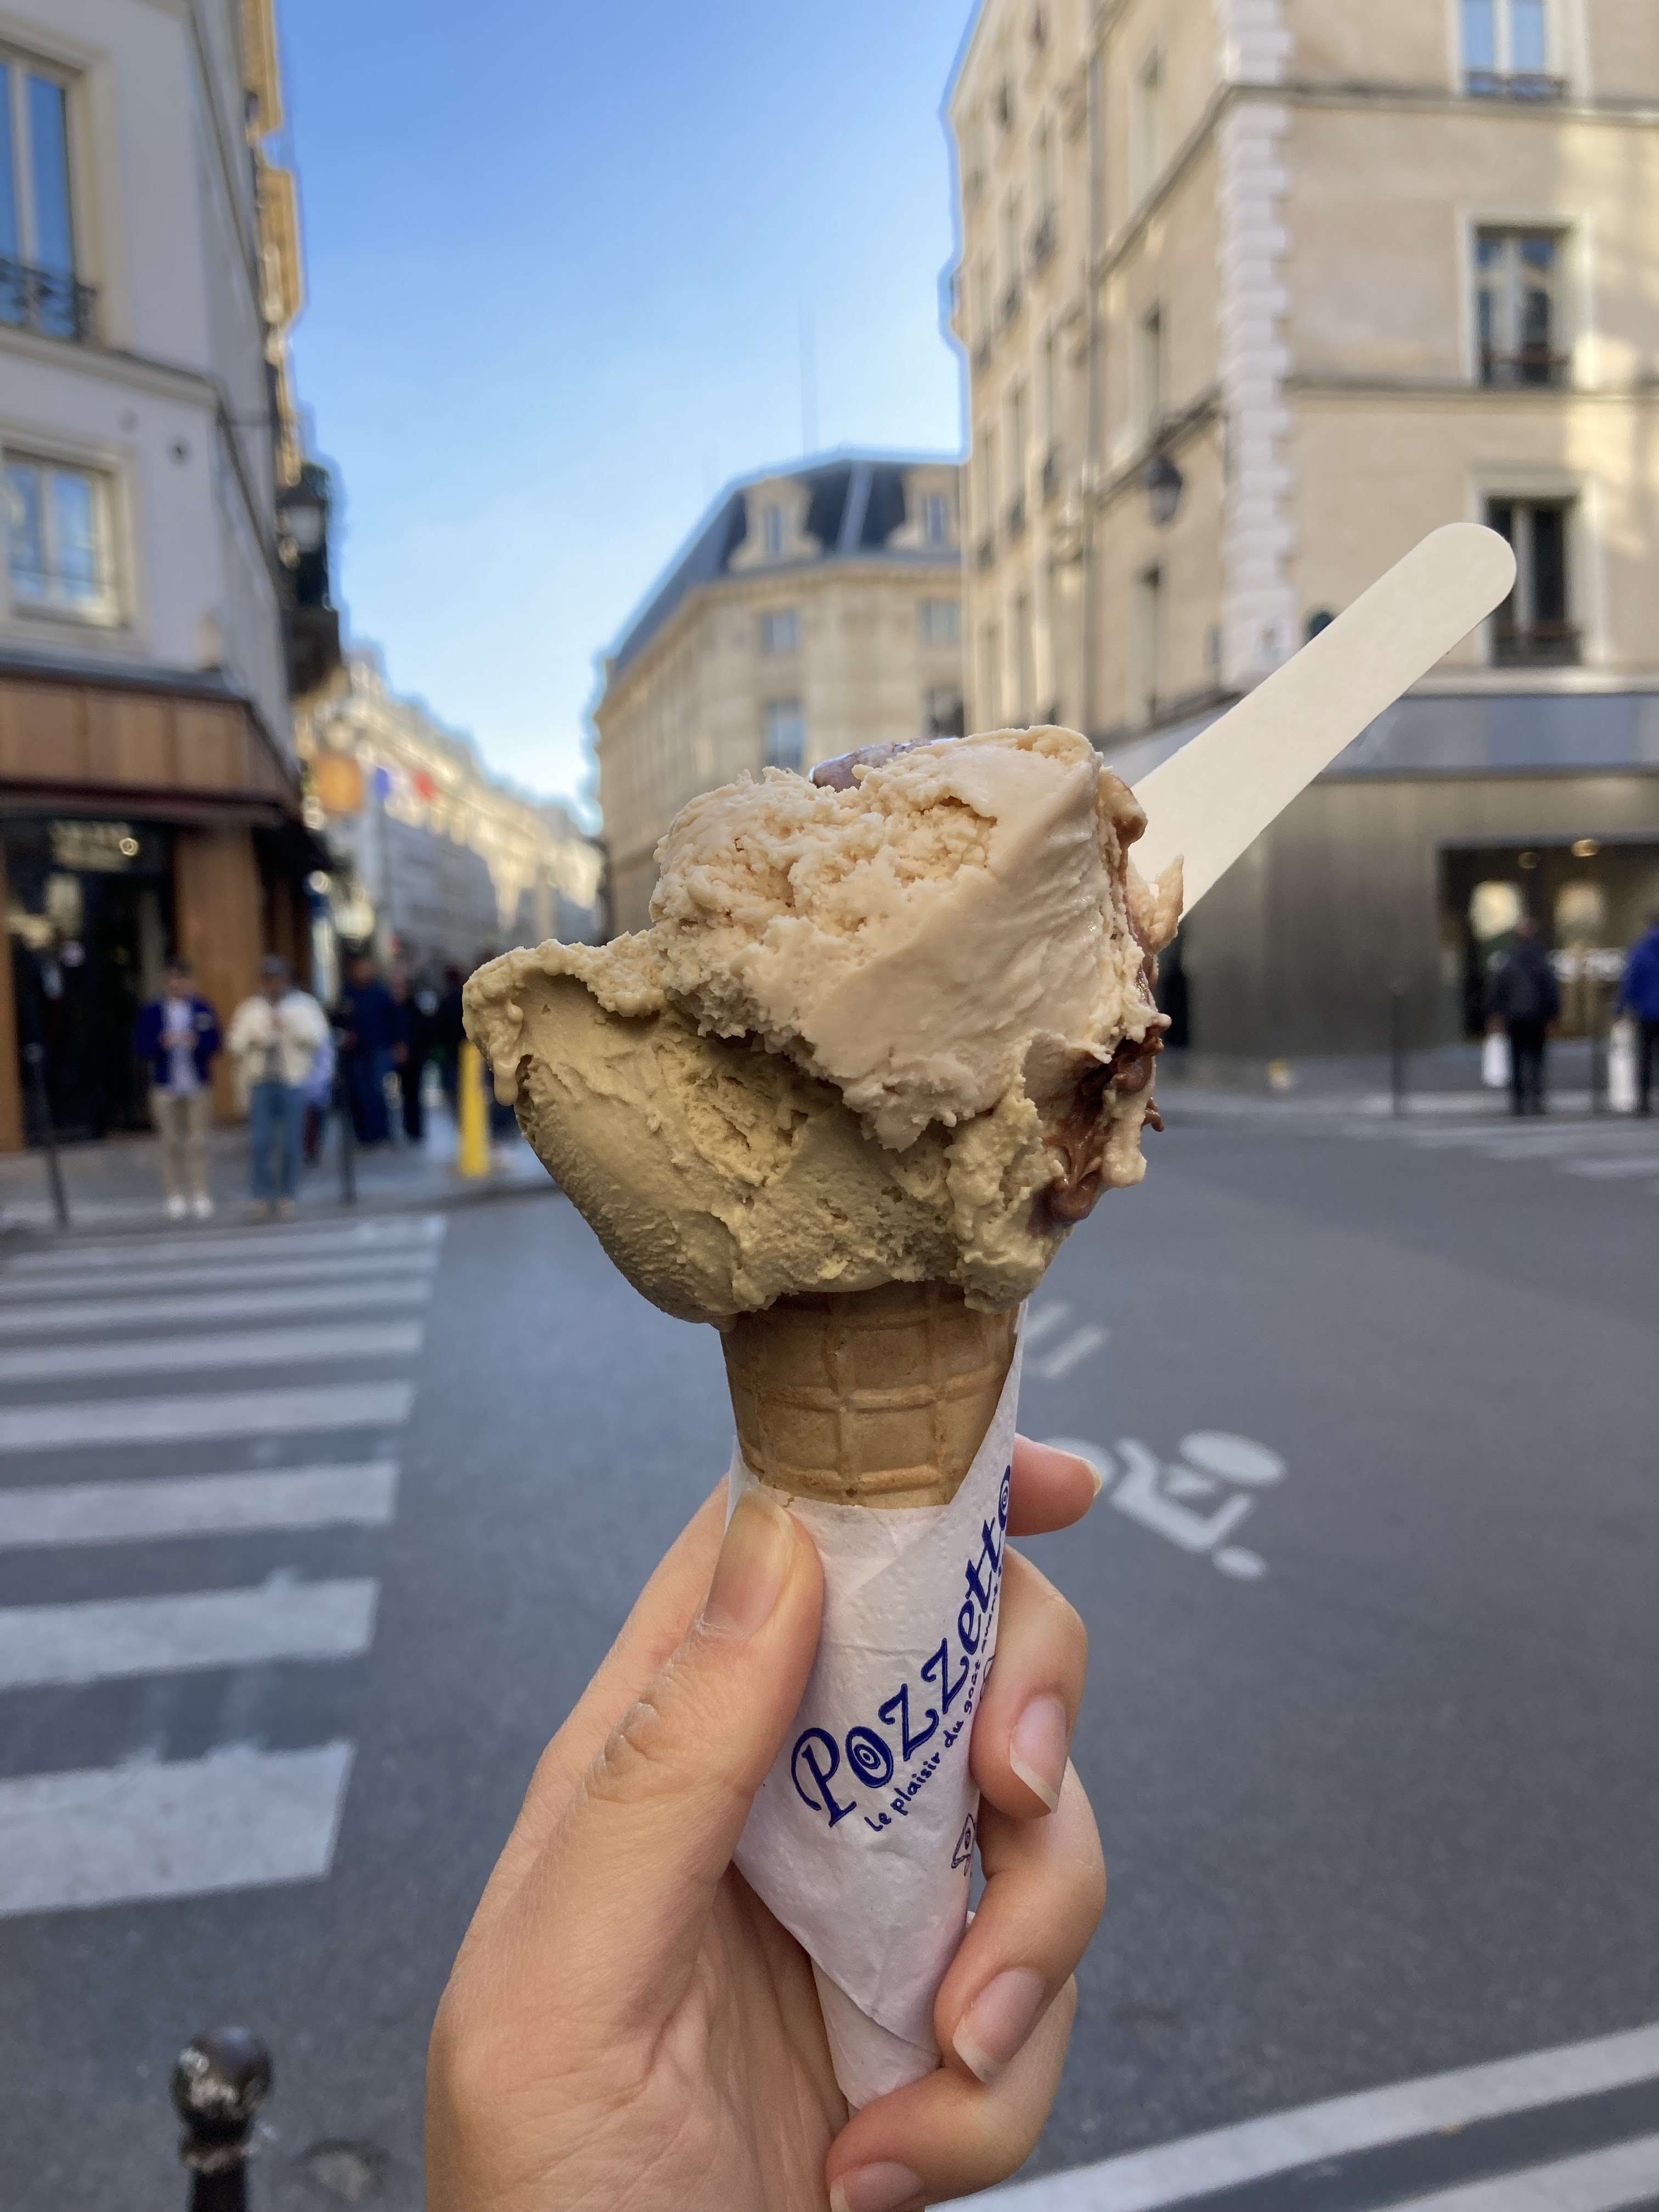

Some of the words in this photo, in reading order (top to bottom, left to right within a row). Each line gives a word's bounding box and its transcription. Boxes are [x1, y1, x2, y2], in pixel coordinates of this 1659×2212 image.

[864, 1812, 891, 1831] le
[890, 1752, 940, 1816] plaisir
[943, 1720, 964, 1748] du
